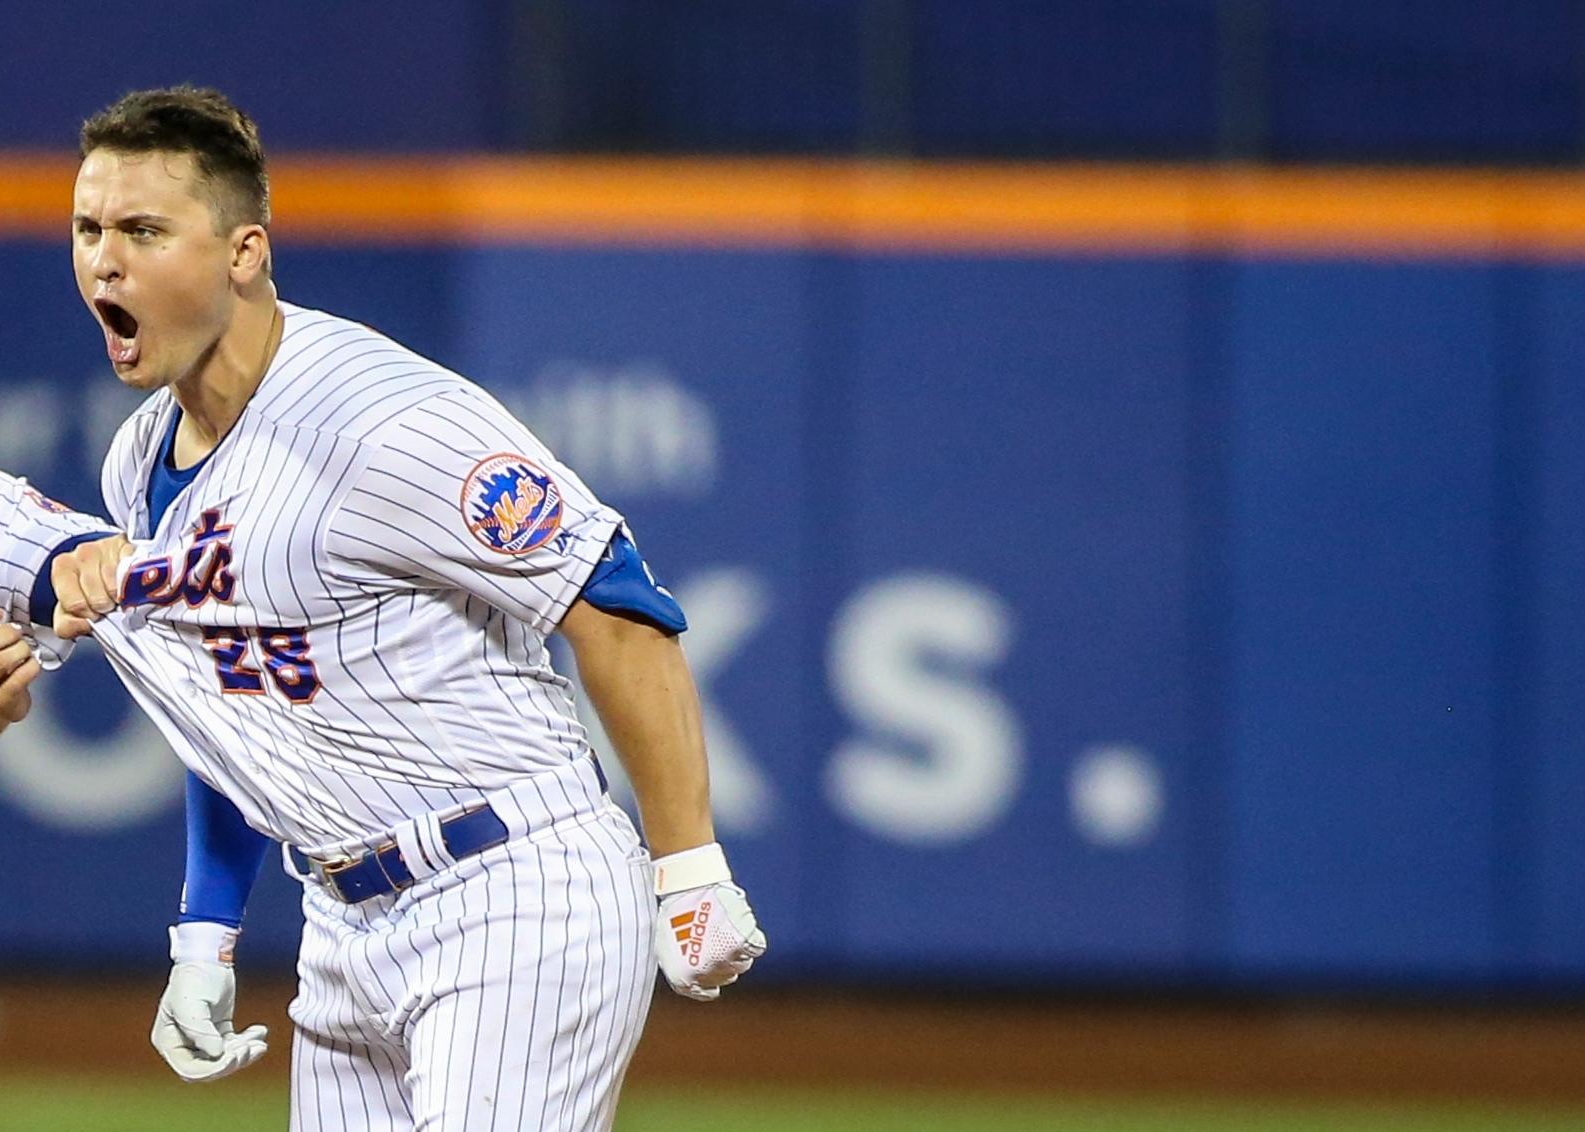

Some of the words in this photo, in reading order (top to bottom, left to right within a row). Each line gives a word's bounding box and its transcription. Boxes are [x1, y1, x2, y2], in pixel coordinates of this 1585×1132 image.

[499, 476, 545, 543] Mets
[120, 507, 236, 610] ets
[688, 901, 711, 966] adidas
